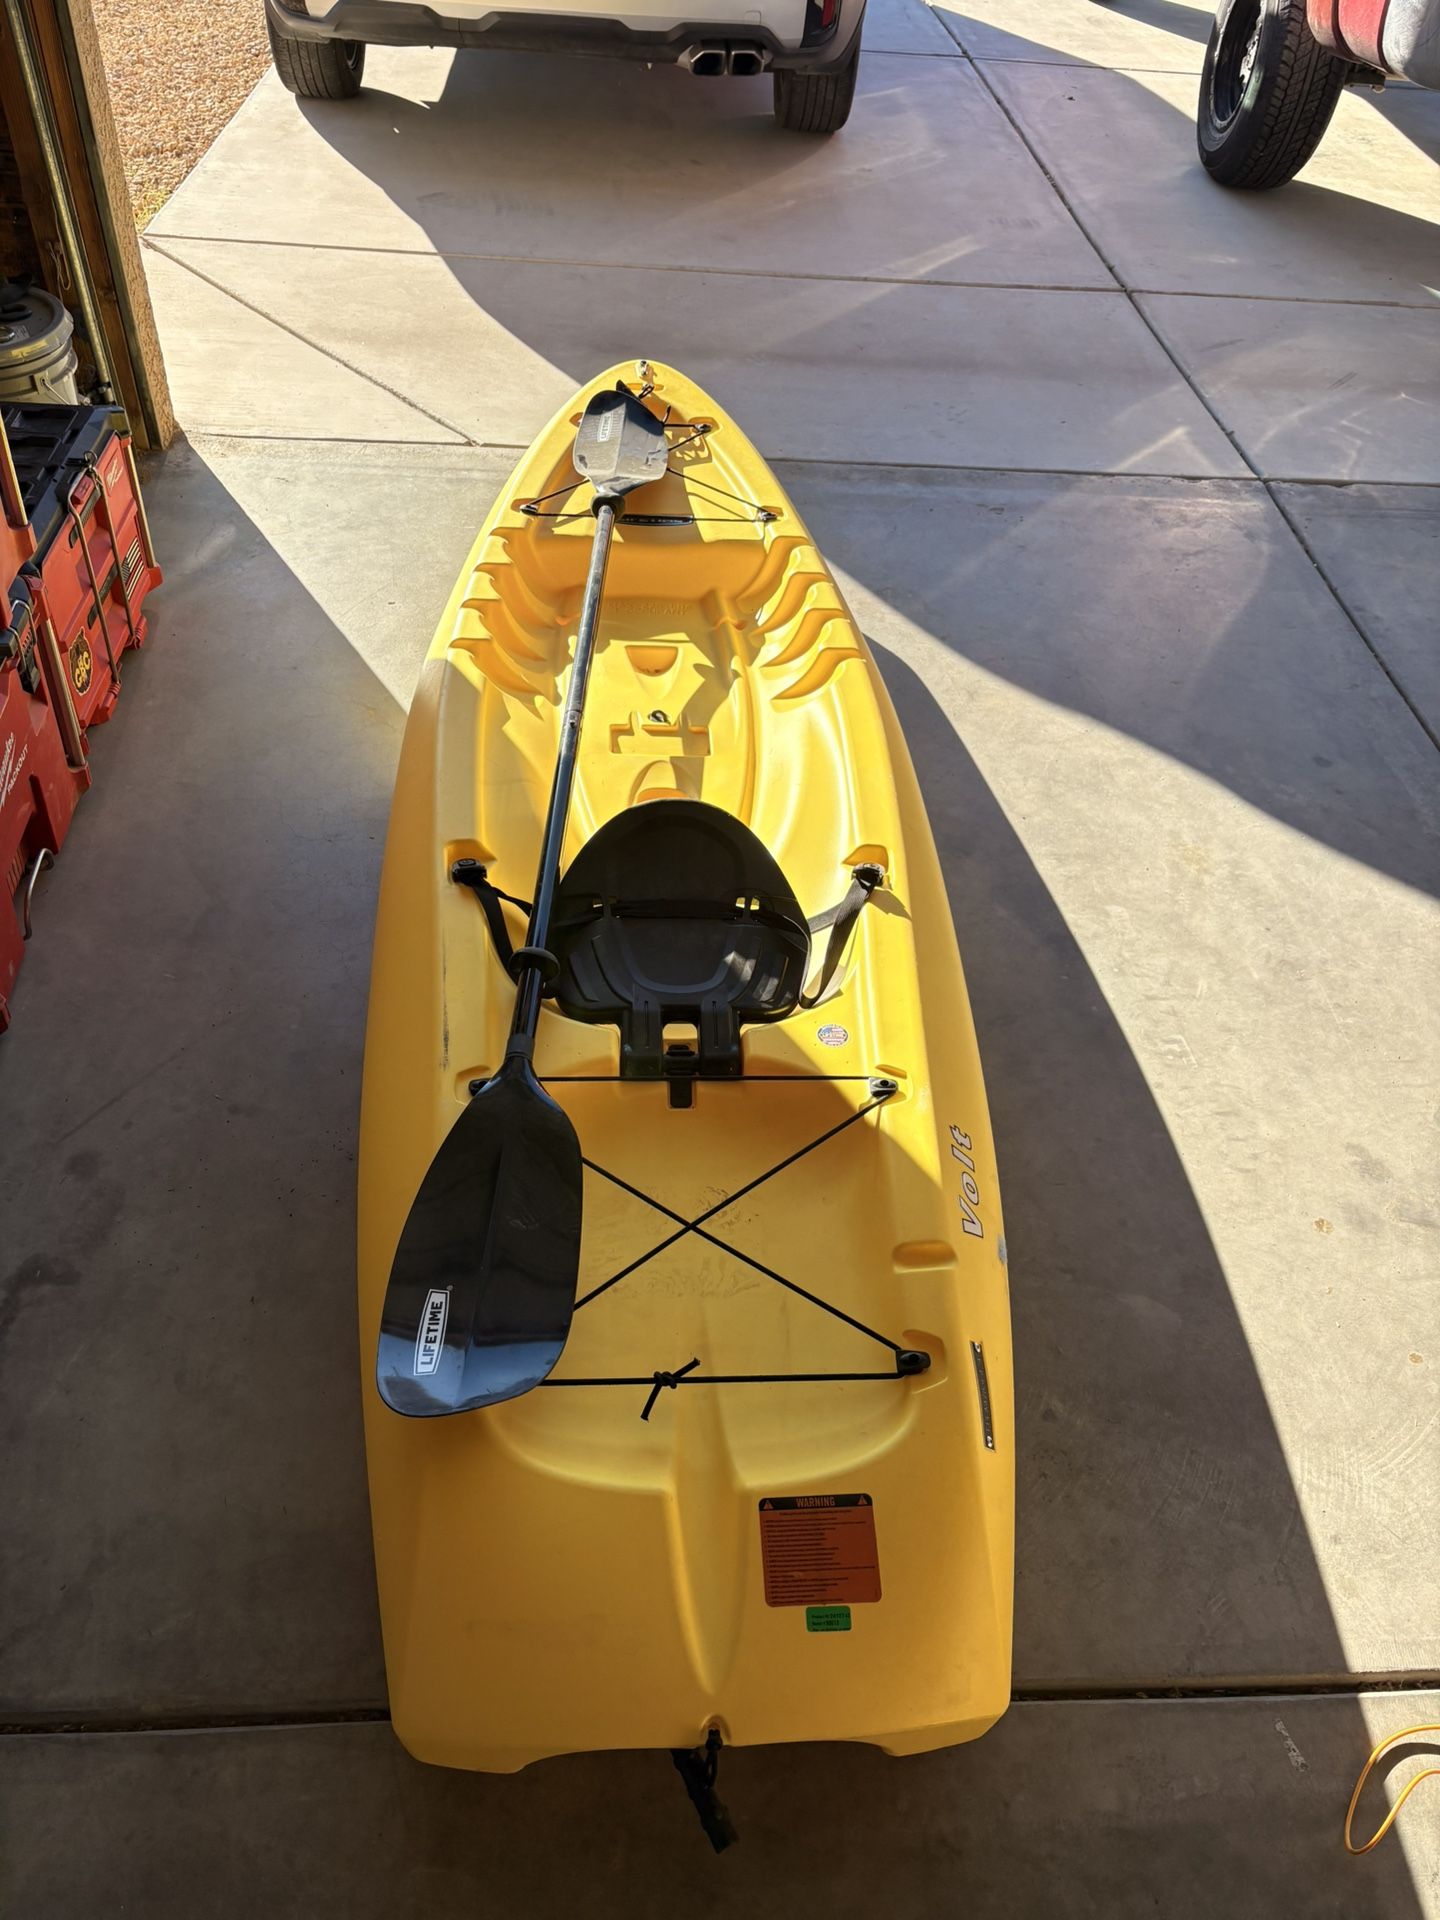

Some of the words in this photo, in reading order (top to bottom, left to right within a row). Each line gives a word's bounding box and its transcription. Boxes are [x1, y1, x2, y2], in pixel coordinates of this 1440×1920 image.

[7, 743, 28, 795] PACKOUT
[949, 1125, 984, 1238] Volt
[420, 1301, 443, 1365] LIFETIME
[796, 1496, 836, 1508] WARNING
